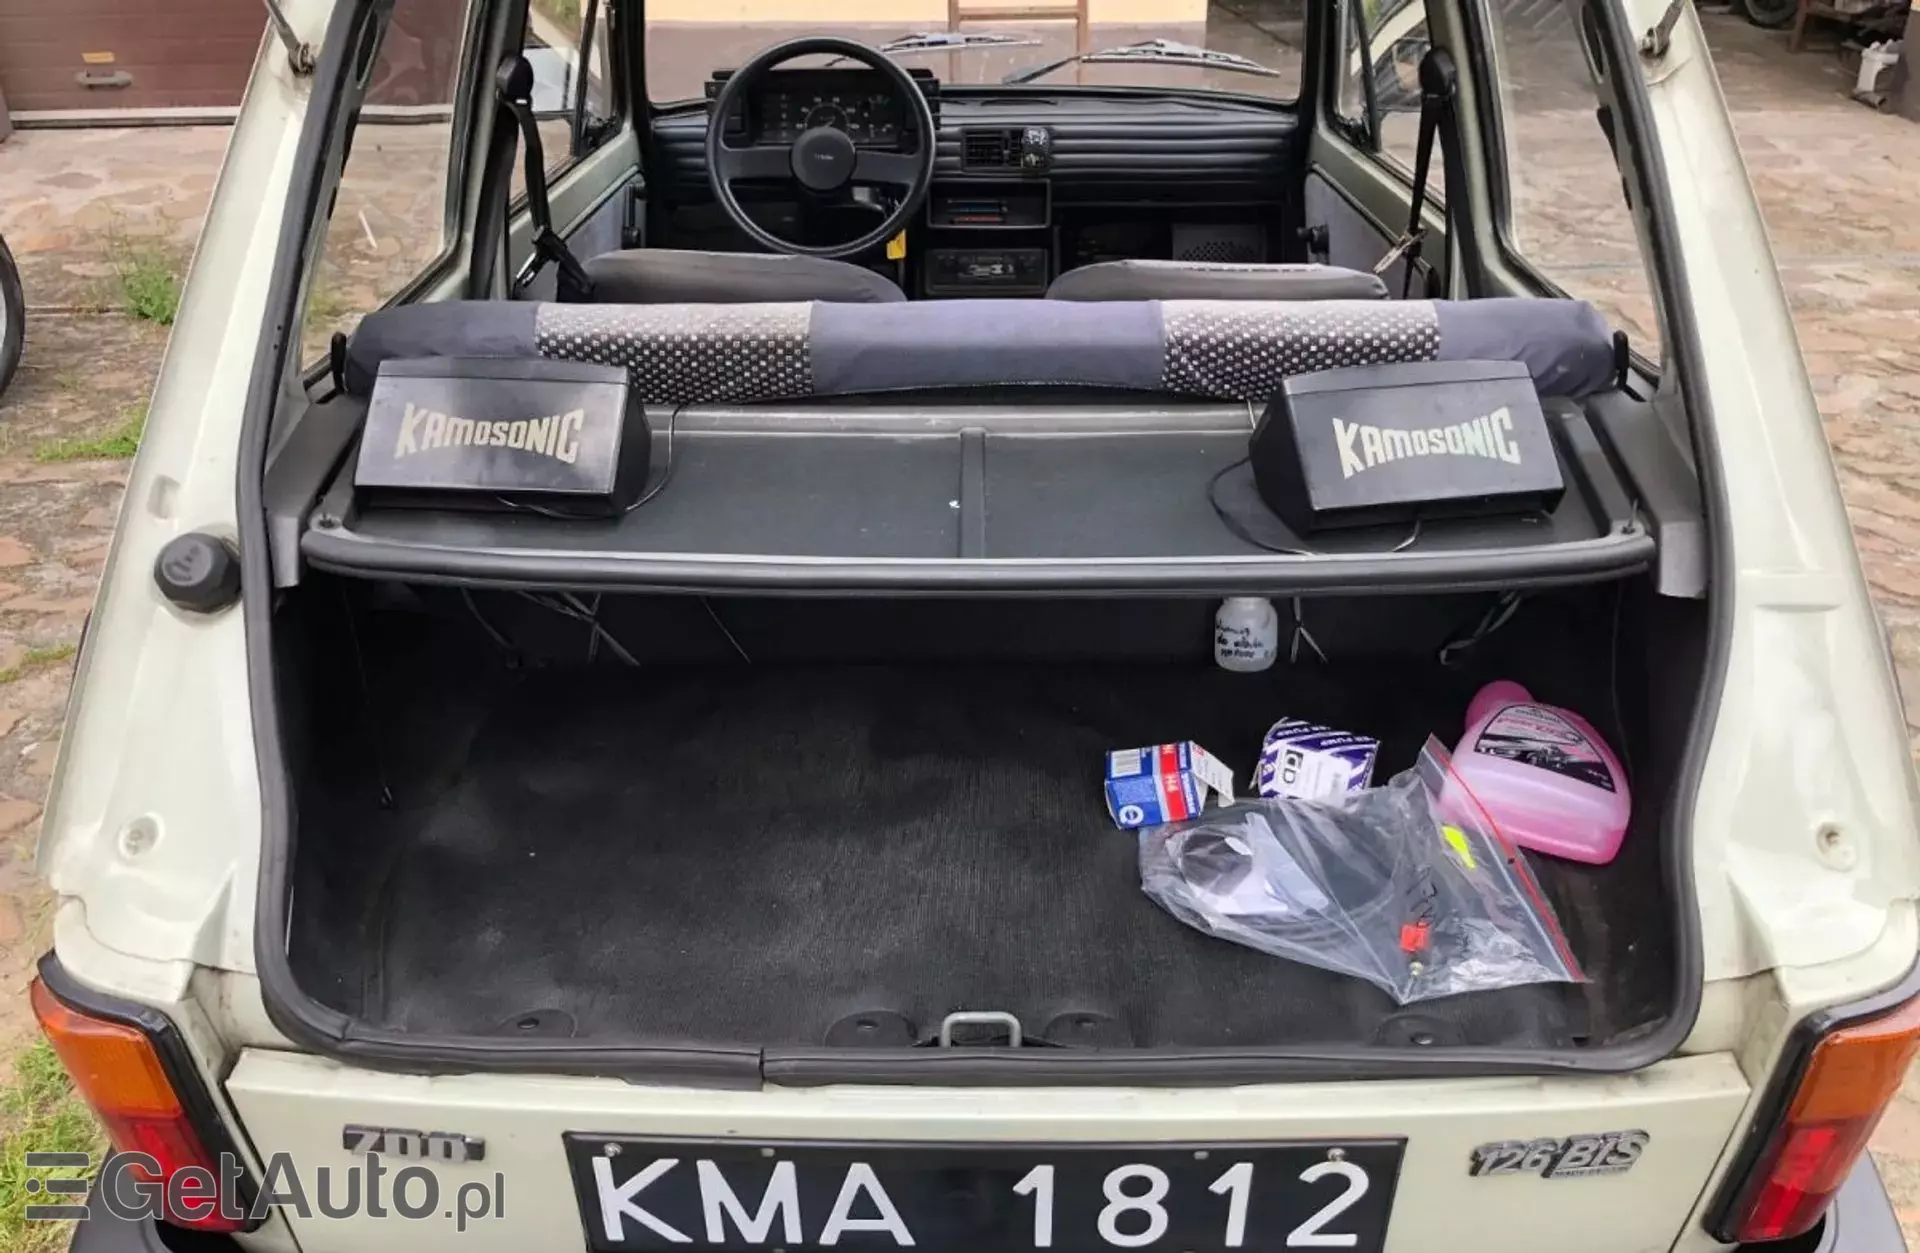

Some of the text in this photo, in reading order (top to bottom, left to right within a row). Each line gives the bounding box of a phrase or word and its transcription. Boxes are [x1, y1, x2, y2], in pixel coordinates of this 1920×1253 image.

[1162, 773, 1181, 794] H4
[1473, 1138, 1556, 1177] 126
[592, 1156, 1369, 1247] KMA 1812
